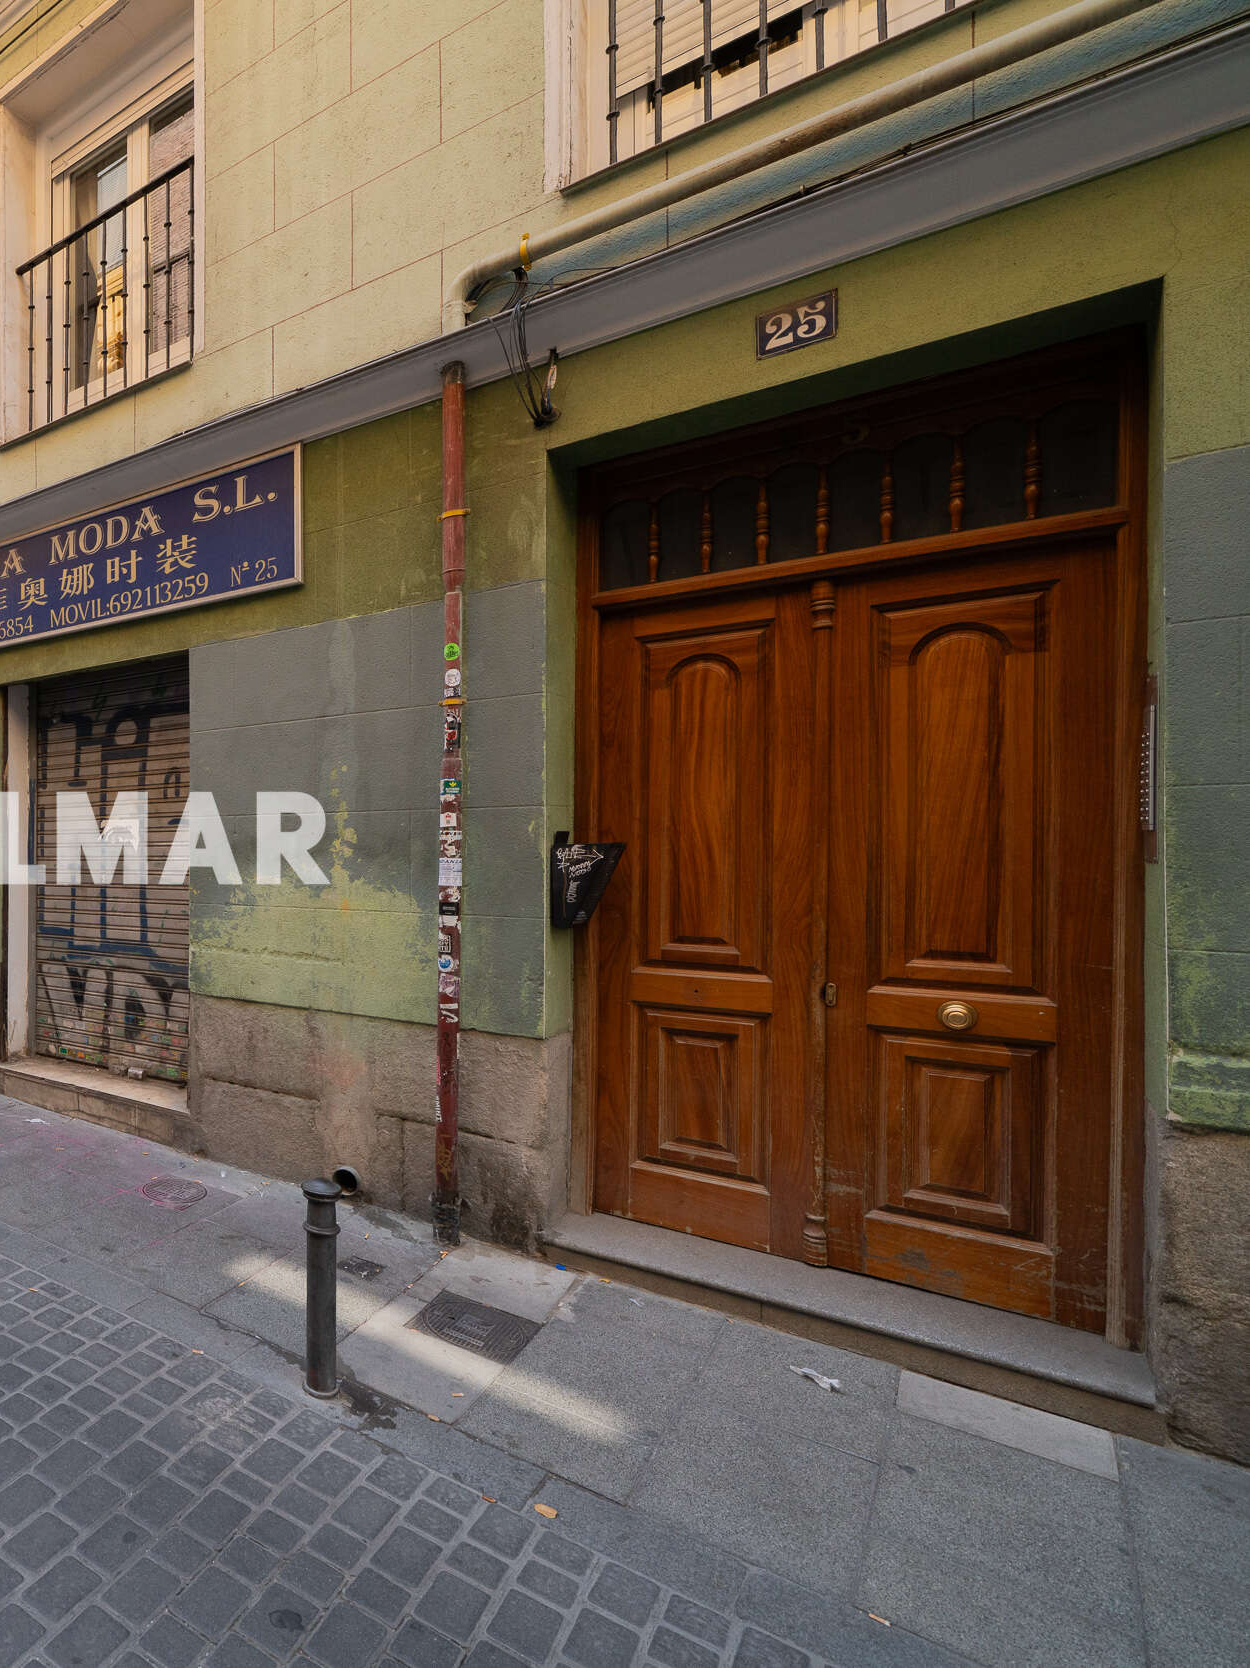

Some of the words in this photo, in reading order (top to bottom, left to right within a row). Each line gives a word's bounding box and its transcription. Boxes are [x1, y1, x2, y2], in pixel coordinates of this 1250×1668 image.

[765, 300, 827, 351] 25
[49, 505, 165, 565] MODA
[192, 475, 278, 523] S.L.
[50, 572, 209, 628] MOVIL:692113259
[254, 557, 278, 582] 25
